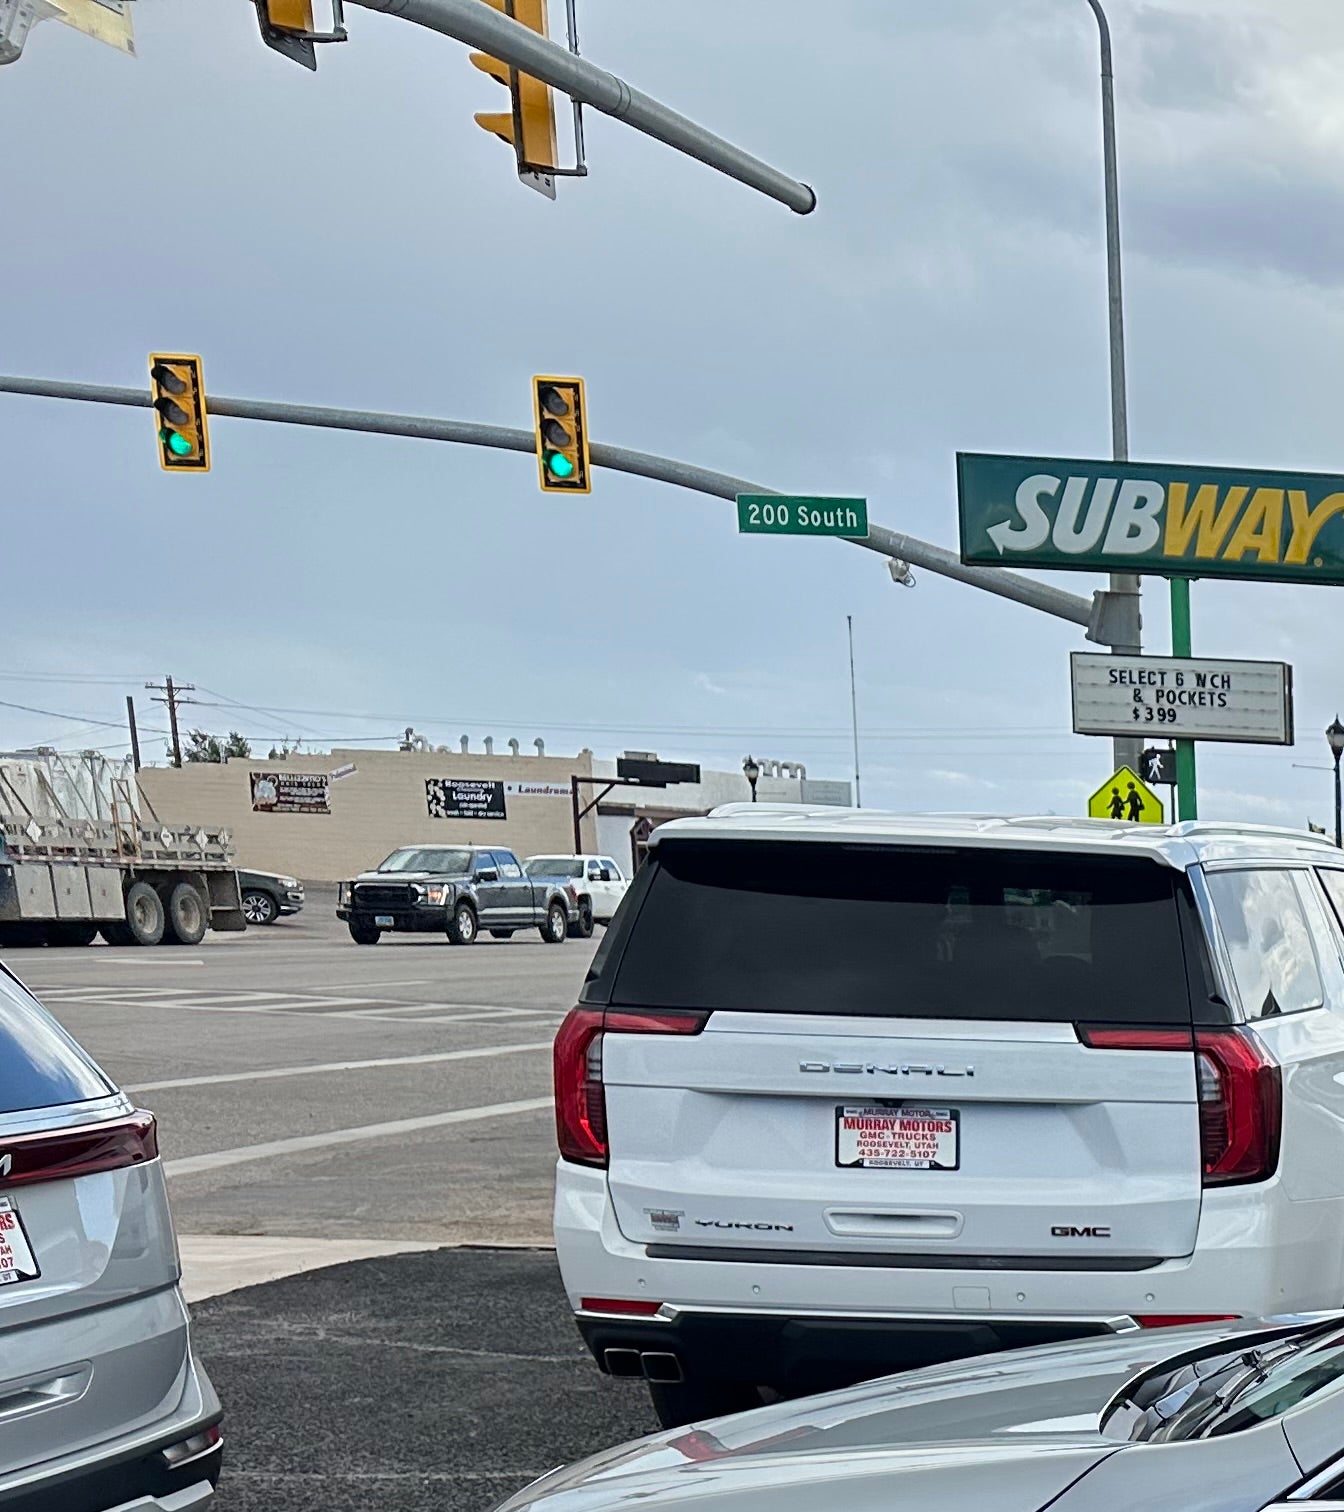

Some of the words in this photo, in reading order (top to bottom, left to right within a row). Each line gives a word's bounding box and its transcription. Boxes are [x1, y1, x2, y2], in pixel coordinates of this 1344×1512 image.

[748, 503, 789, 526] 200
[797, 505, 857, 528] South
[1109, 668, 1167, 687] SELECT
[1175, 671, 1184, 687] 6
[1133, 688, 1144, 703] &
[1155, 689, 1227, 708] POCKETS
[518, 784, 574, 795] Laundroma
[452, 790, 493, 803] Laundry
[799, 1060, 975, 1077] DENALI
[843, 1118, 896, 1131] MURRAY
[899, 1119, 952, 1133] MOTORS
[860, 1130, 885, 1140] GMC
[892, 1131, 937, 1141] TRUCKS
[914, 1141, 939, 1150] UTAH
[858, 1149, 937, 1159] 435-722-5107
[694, 1219, 794, 1232] YUKON
[1050, 1226, 1112, 1238] GMC
